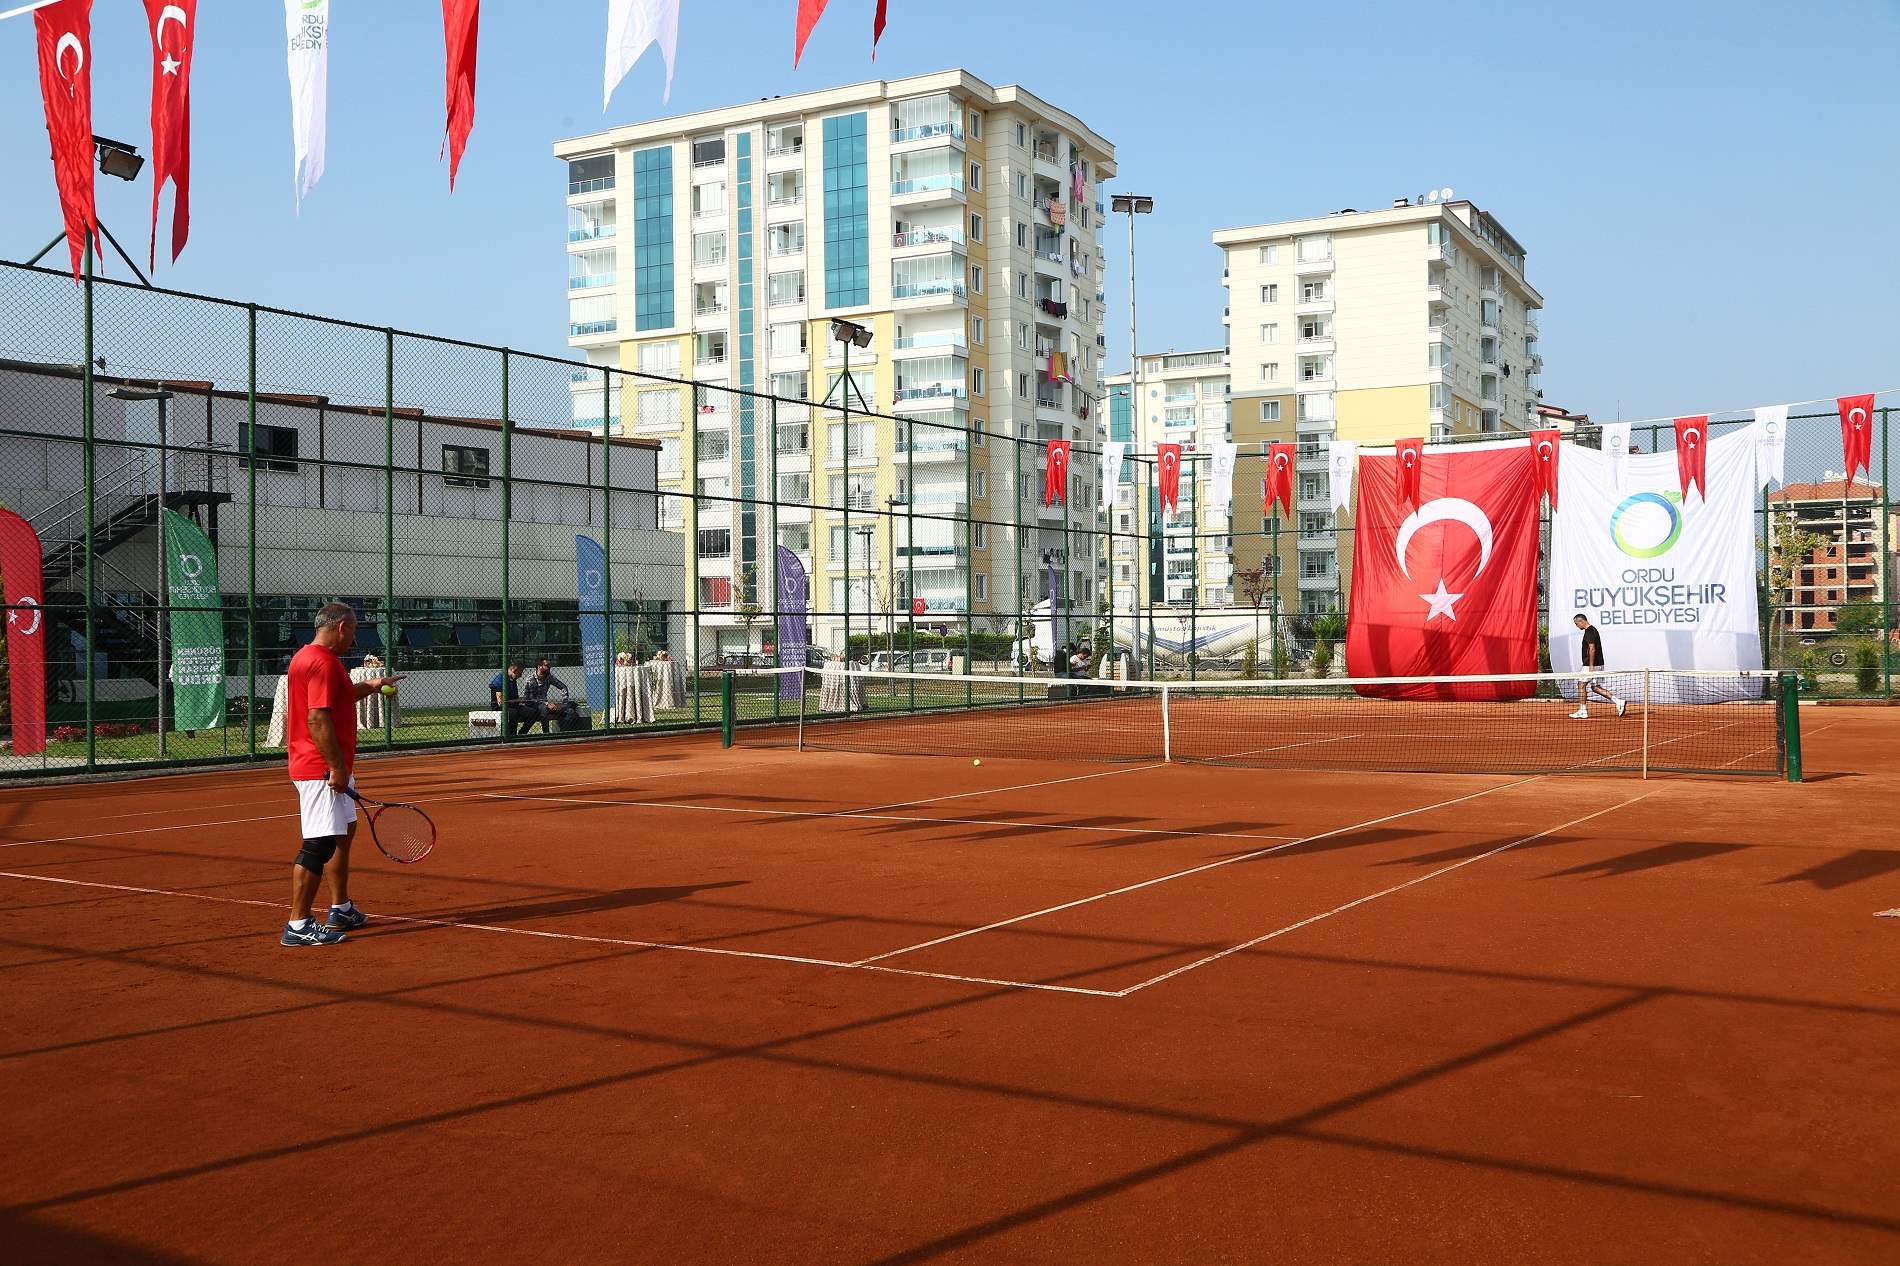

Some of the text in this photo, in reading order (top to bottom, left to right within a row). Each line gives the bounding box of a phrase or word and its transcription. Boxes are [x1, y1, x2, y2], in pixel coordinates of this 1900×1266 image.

[1622, 568, 1675, 583] ORDU
[1574, 584, 1726, 608] BÜYÜKŞEHİR
[1600, 607, 1700, 625] BELEDİYESİ
